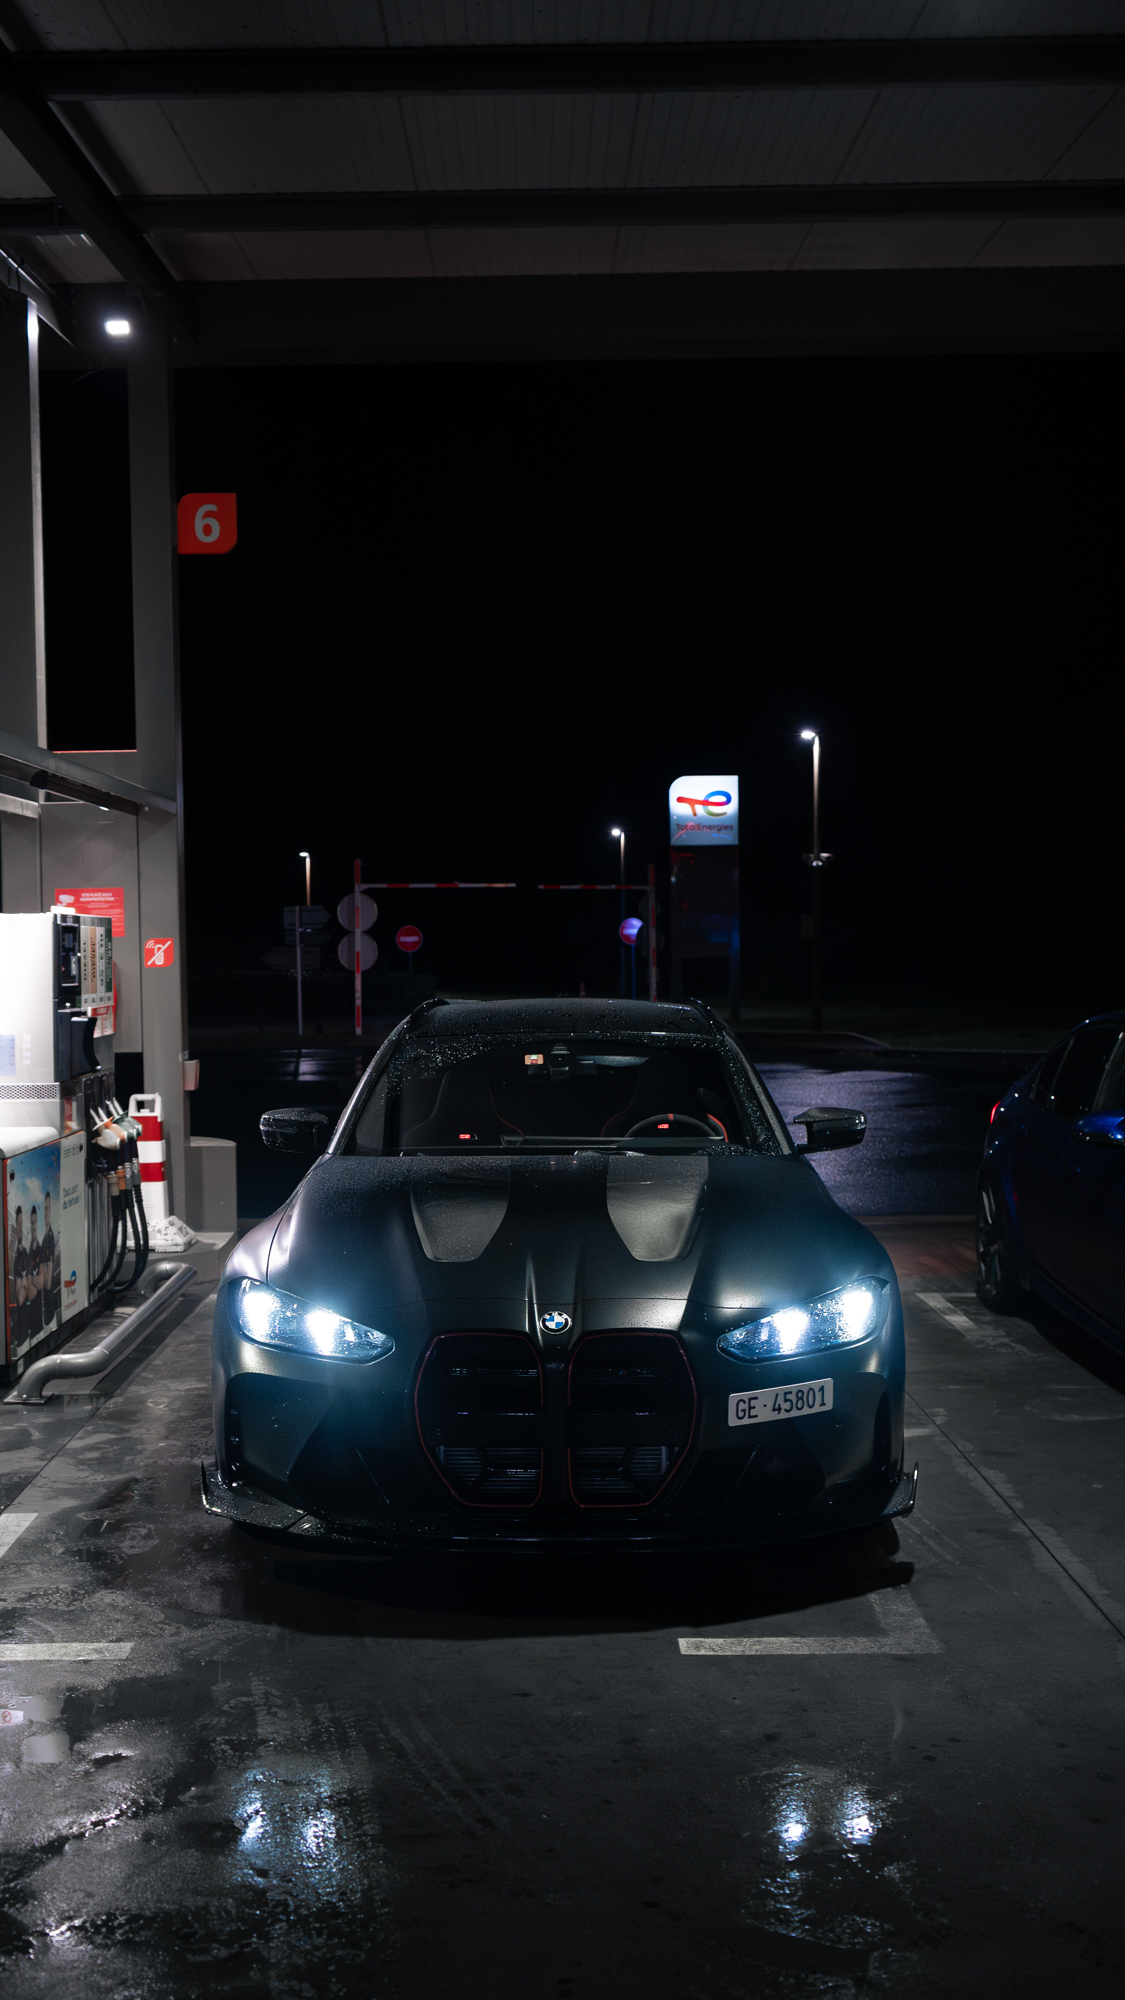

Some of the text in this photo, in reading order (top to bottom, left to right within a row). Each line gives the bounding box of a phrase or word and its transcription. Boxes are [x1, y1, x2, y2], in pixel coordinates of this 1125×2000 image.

[194, 503, 220, 543] 6
[675, 822, 734, 832] TotalEnergies
[735, 1396, 759, 1421] GE
[771, 1384, 827, 1415] 45801
